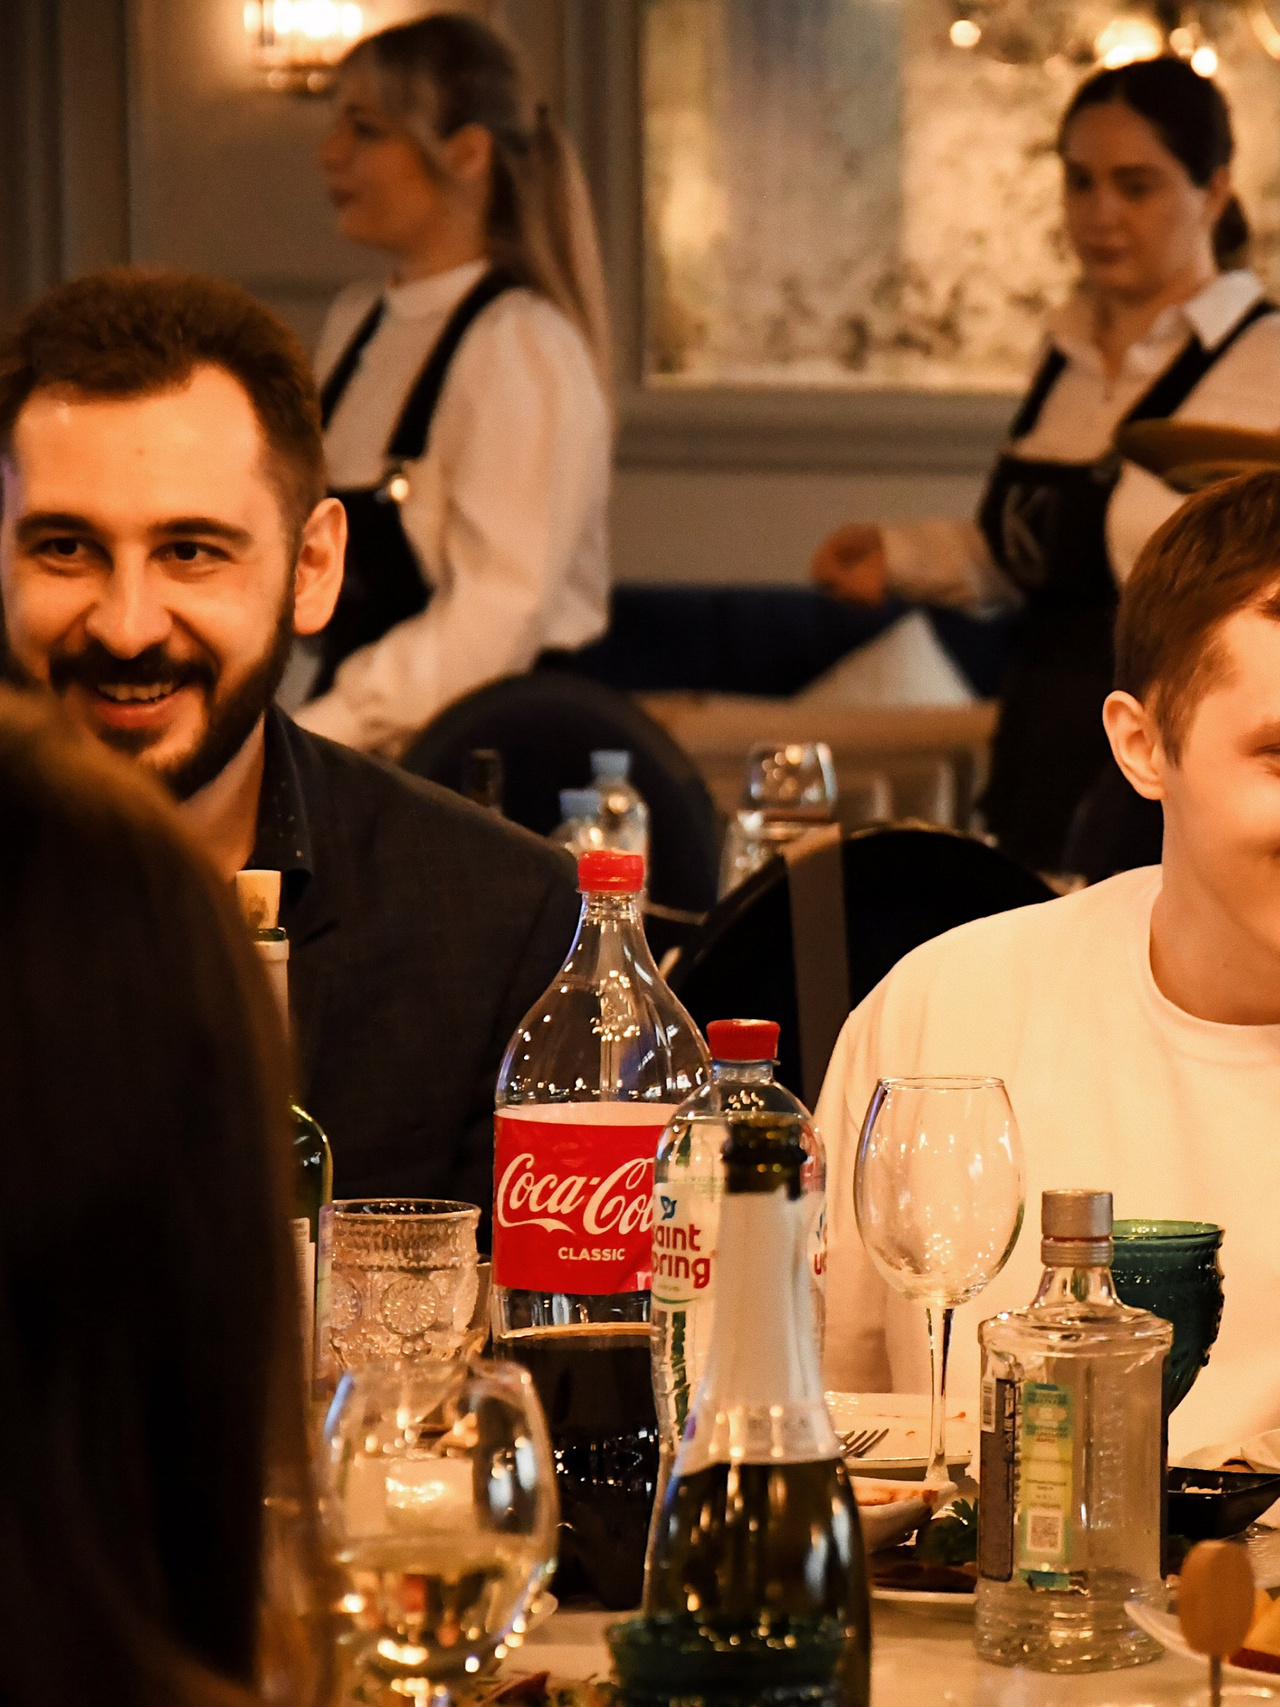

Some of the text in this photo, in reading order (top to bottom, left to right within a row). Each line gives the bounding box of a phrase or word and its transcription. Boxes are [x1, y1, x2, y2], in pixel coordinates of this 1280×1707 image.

[496, 1153, 654, 1235] Coca-Col
[652, 1224, 702, 1252] aint
[558, 1247, 626, 1261] CLASSIC
